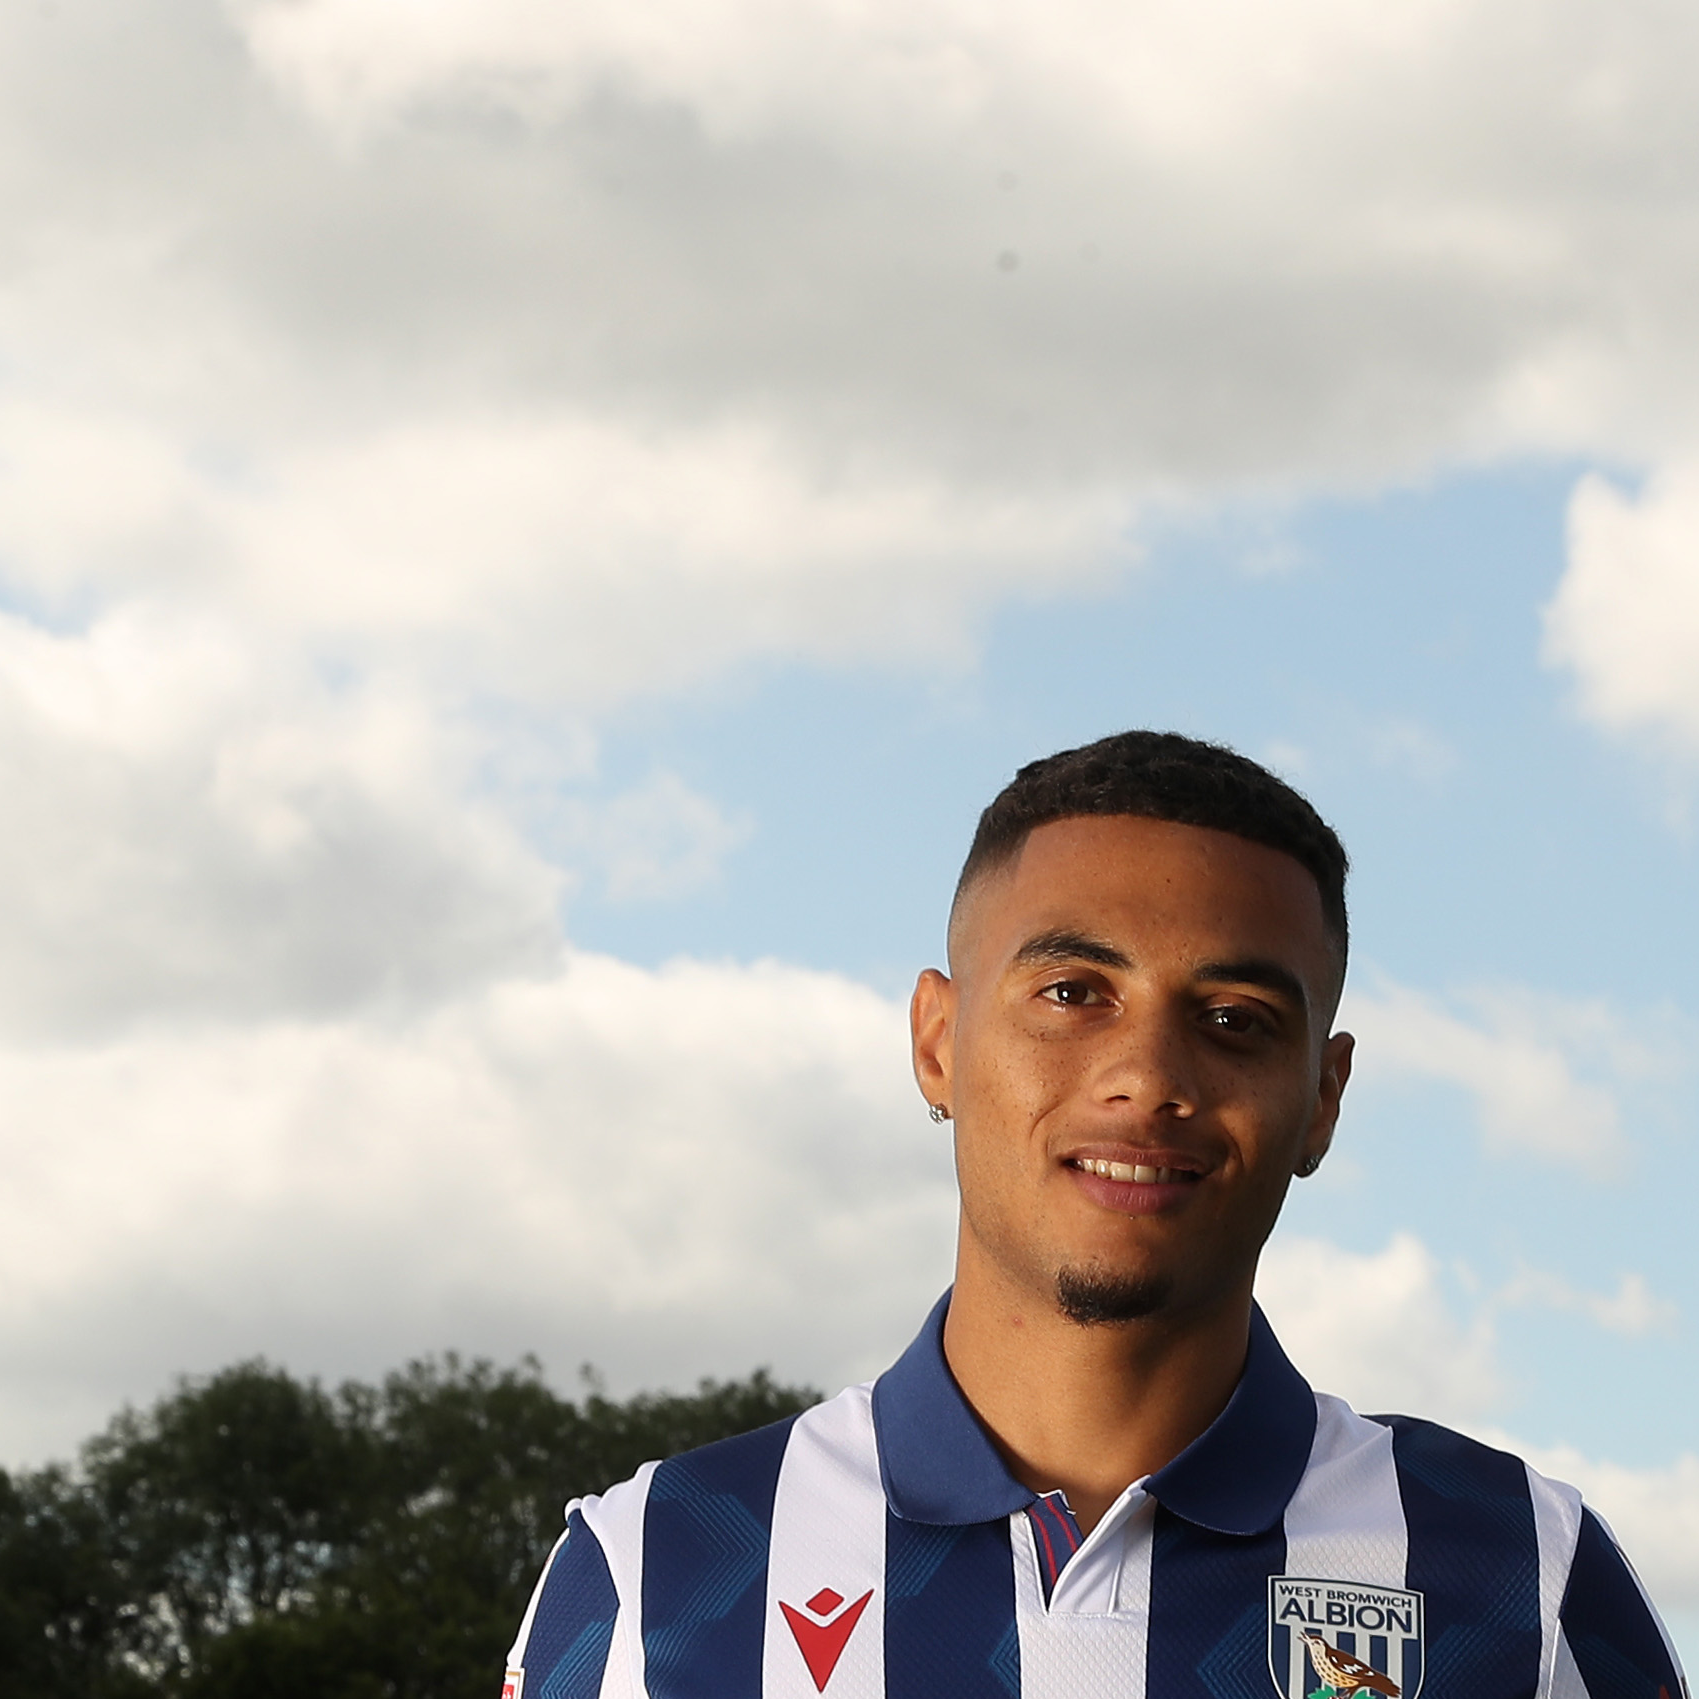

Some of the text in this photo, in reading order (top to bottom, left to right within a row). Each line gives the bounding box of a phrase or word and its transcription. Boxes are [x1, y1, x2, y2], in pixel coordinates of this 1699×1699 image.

[1279, 1584, 1412, 1609] WEST BROMWICH
[1279, 1598, 1412, 1634] ALBION
